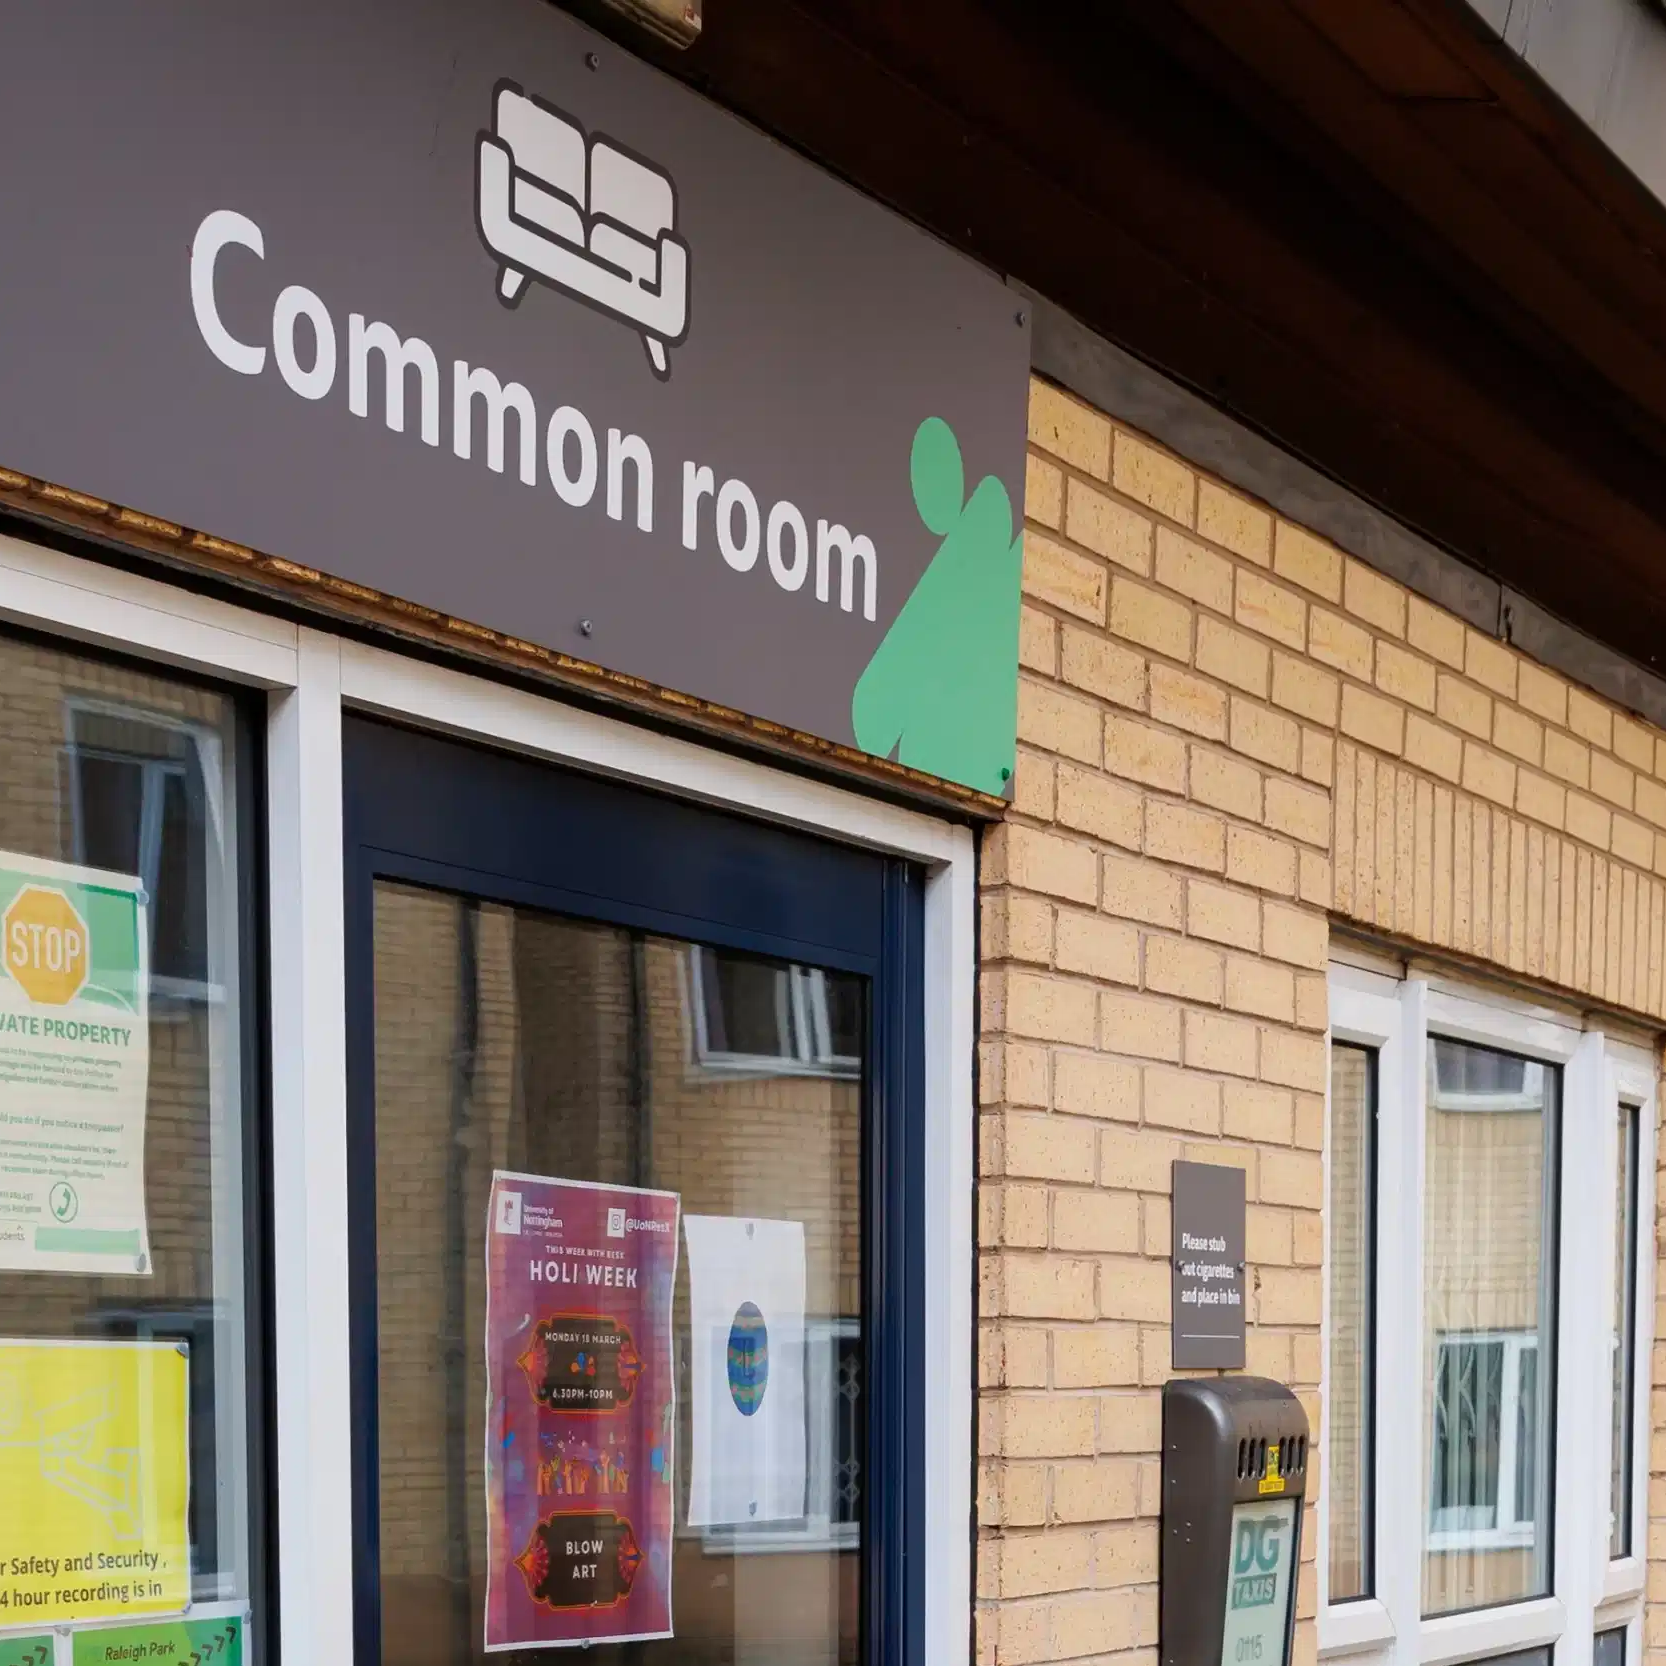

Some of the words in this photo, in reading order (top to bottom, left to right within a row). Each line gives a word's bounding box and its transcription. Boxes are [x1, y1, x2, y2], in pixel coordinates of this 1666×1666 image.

[189, 209, 654, 533] Common
[681, 460, 877, 622] room
[10, 920, 81, 973] STOP
[44, 1018, 131, 1047] PROPERTY
[524, 1215, 562, 1230] Nottingham
[566, 1247, 585, 1256] WEEK
[1182, 1233, 1208, 1251] Please
[1209, 1236, 1226, 1252] stub
[529, 1260, 578, 1284] HOLI
[585, 1264, 637, 1288] WEEK
[1197, 1260, 1234, 1282] cigarettes
[1181, 1286, 1197, 1302] and
[1198, 1287, 1219, 1308] place
[1219, 1288, 1227, 1304] in
[1228, 1288, 1240, 1304] bin
[545, 1332, 580, 1342] MONDAY
[592, 1335, 621, 1344] MARCH
[553, 1388, 613, 1399] 6.30PM-10PM
[566, 1540, 603, 1555] BLOW
[1234, 1516, 1280, 1574] DG
[11, 1556, 59, 1577] Safety
[64, 1552, 93, 1572] and
[97, 1549, 158, 1571] Security
[573, 1564, 597, 1578] ART
[13, 1587, 50, 1606] hour
[55, 1582, 129, 1604] recording
[133, 1580, 144, 1598] is
[149, 1579, 162, 1597] in
[105, 1643, 146, 1662] Raleigh
[150, 1640, 175, 1656] Park
[1235, 1634, 1263, 1662] 0115
